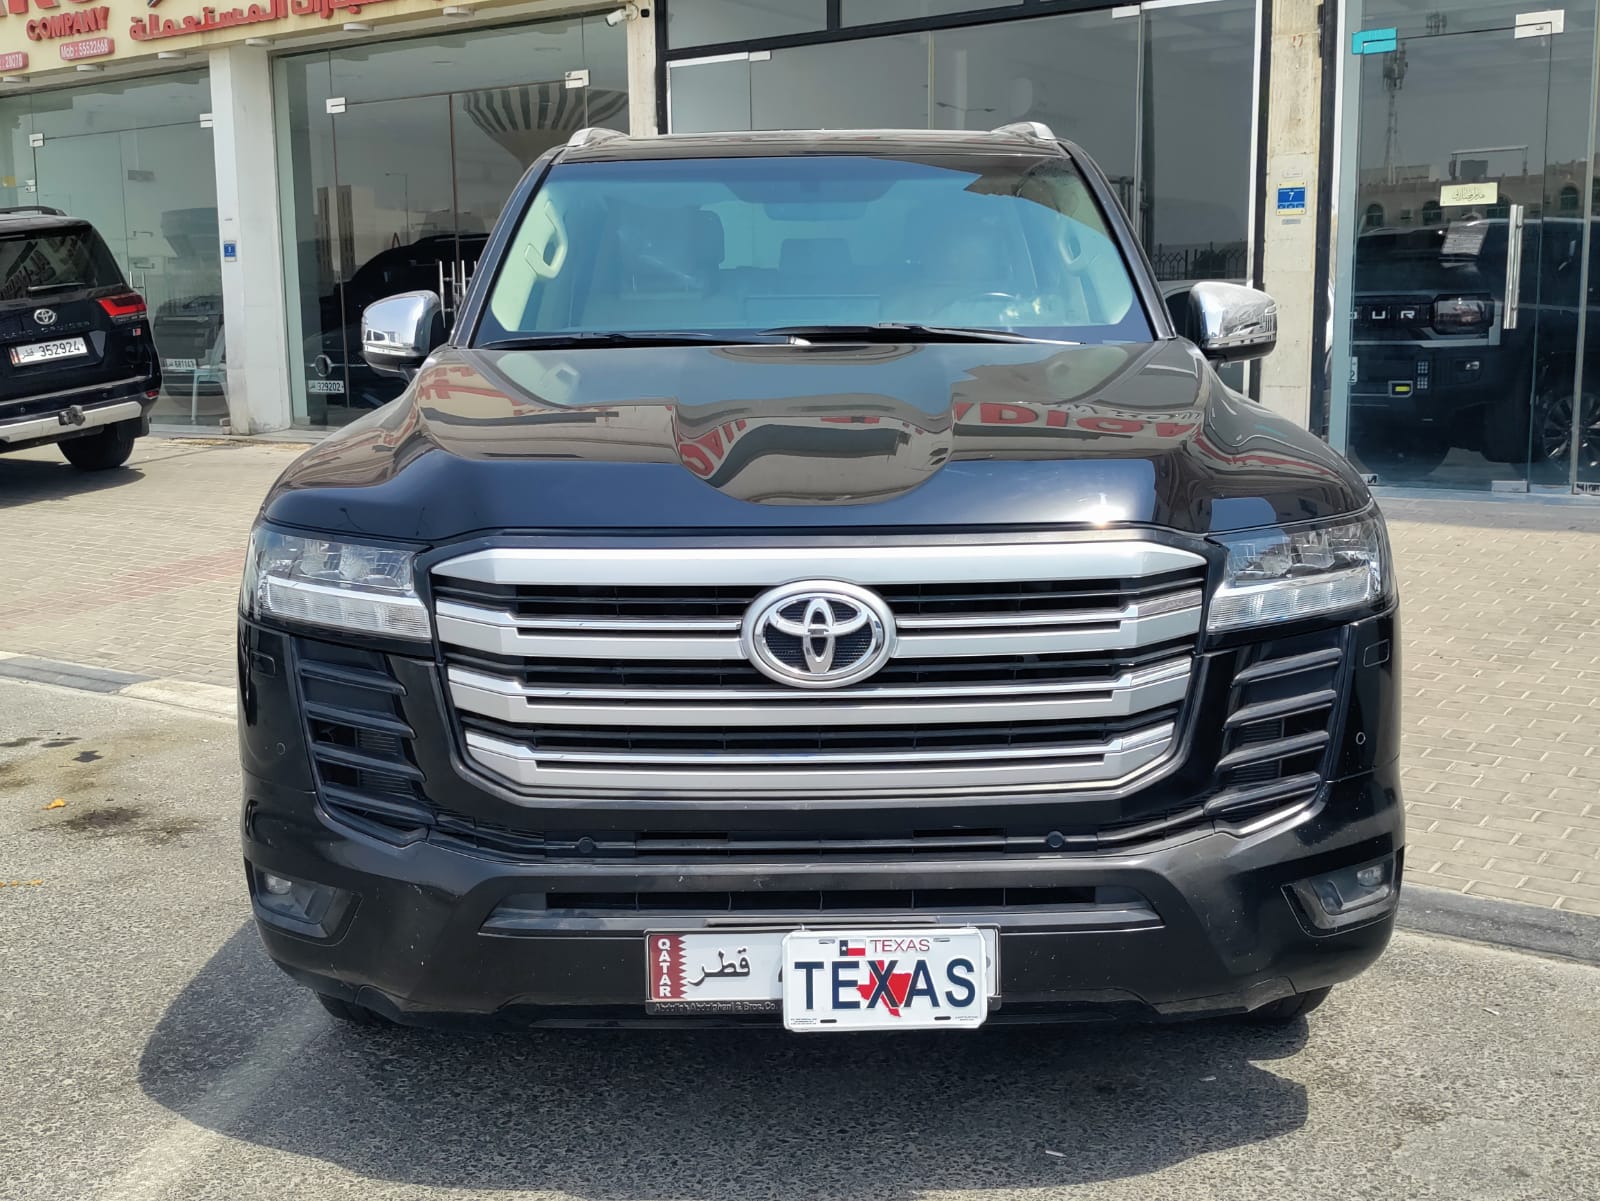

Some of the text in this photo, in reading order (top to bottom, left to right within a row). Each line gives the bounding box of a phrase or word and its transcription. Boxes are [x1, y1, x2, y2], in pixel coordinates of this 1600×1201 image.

[26, 6, 110, 41] COMPANY
[1288, 191, 1295, 201] 7
[38, 341, 81, 358] 352924
[870, 939, 931, 953] TEXAS
[657, 938, 672, 997] QATAR
[686, 946, 752, 987] قطر
[794, 956, 977, 1010] TEXAS
